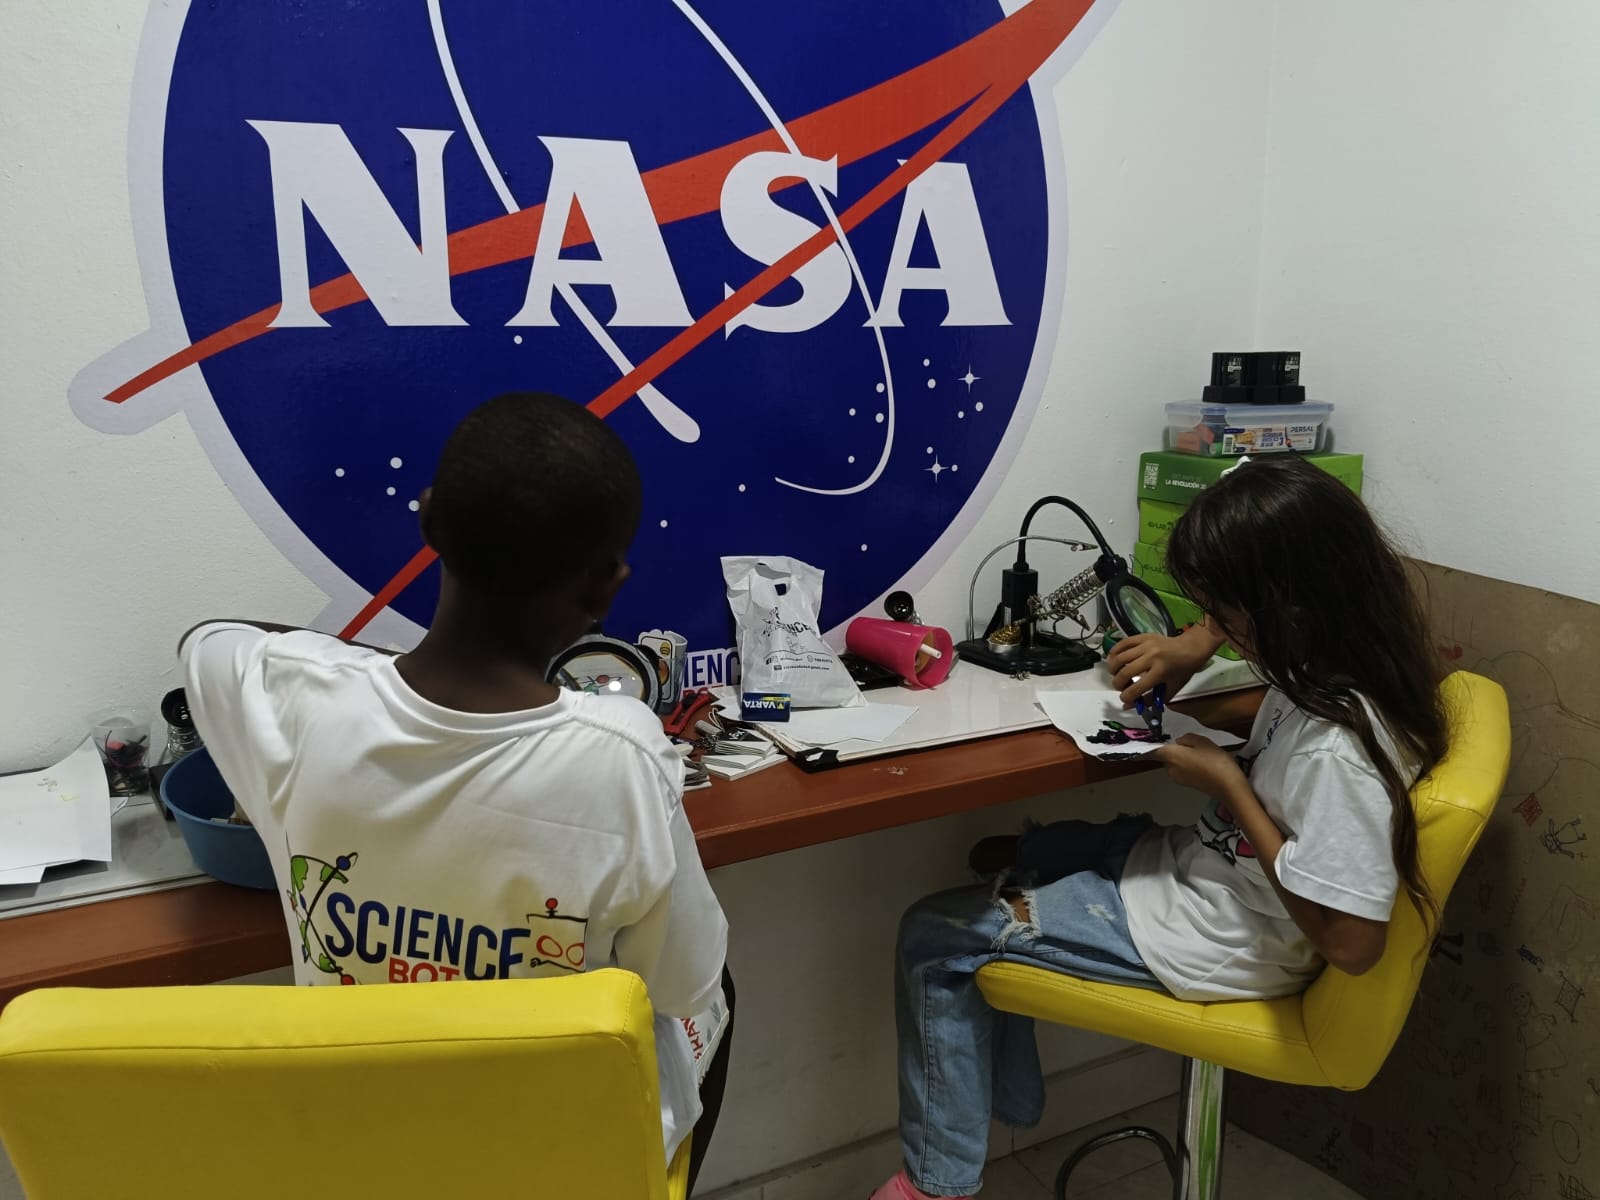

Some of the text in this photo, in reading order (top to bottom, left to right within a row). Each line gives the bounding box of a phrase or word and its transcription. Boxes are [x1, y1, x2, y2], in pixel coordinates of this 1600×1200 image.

[245, 119, 1013, 340] NASA
[743, 699, 776, 709] VARTA
[325, 892, 531, 980] SCIENCE
